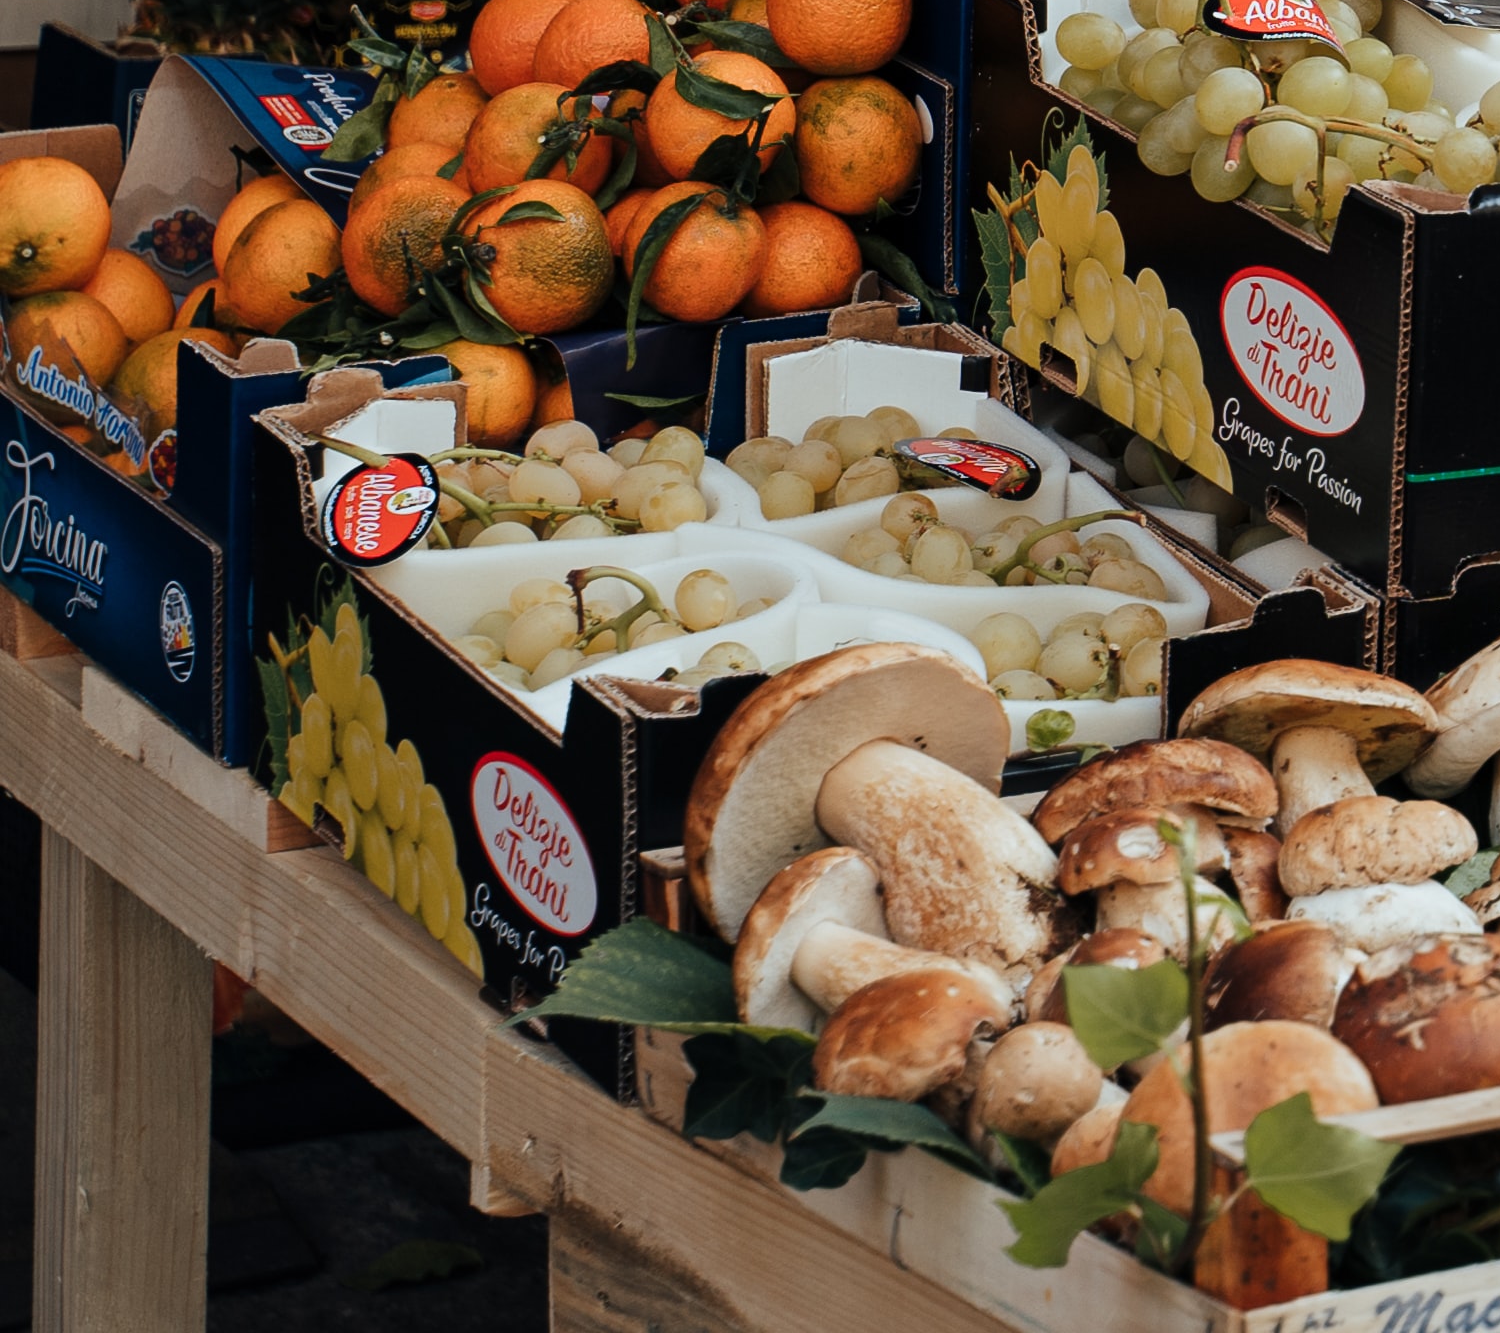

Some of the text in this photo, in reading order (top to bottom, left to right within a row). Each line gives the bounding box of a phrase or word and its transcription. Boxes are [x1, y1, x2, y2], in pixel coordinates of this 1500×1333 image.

[1245, 281, 1337, 376] Delizie
[16, 345, 147, 469] Antonio Forcina
[1246, 338, 1332, 425] di Trani
[1218, 396, 1363, 516] Grapes for Passion
[0, 439, 108, 586] Forcina
[353, 473, 398, 555] Albanese
[493, 767, 574, 870] Delizie
[470, 882, 546, 965] Grapes for
[494, 827, 570, 924] di Trani
